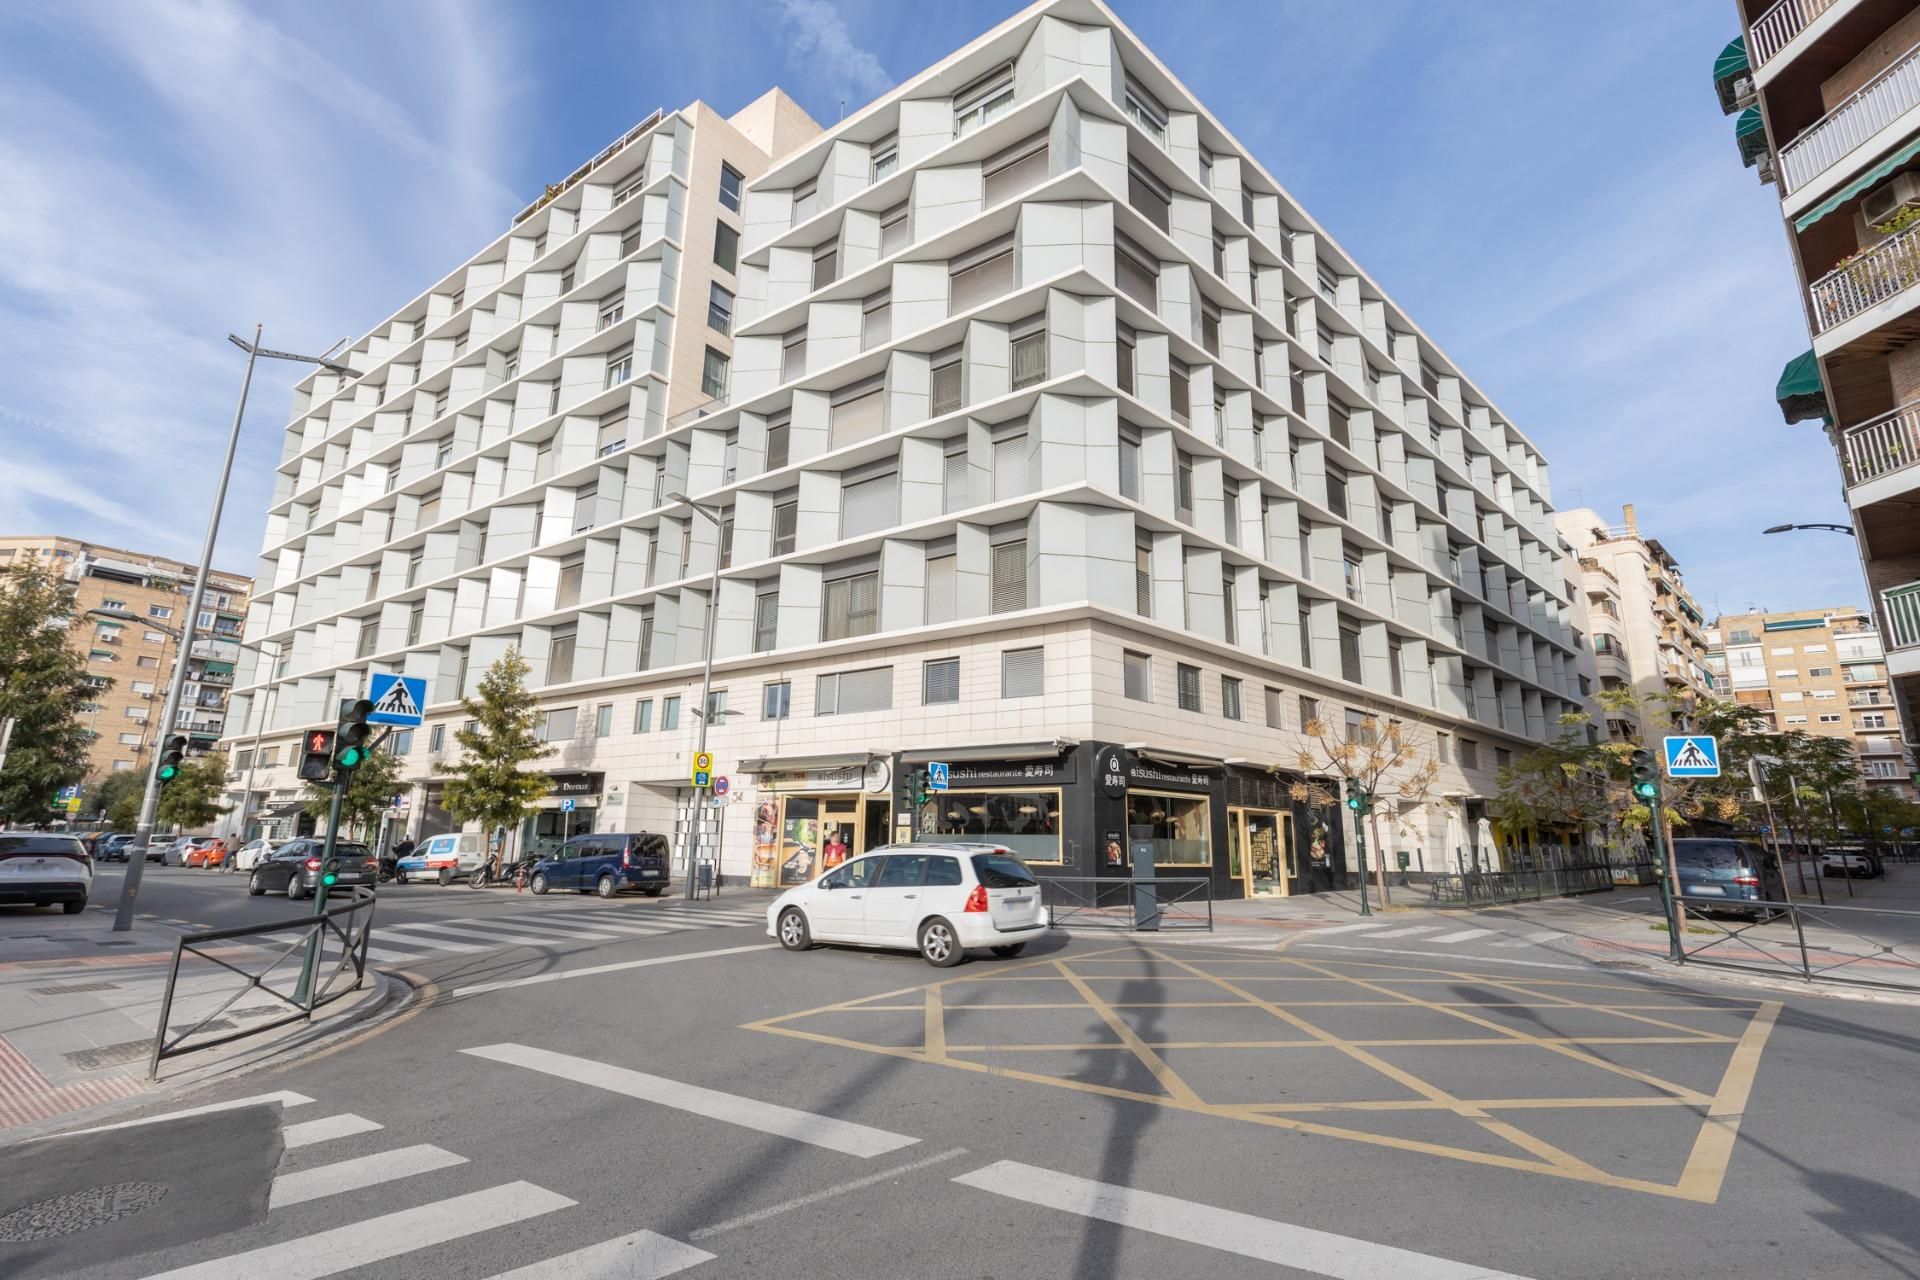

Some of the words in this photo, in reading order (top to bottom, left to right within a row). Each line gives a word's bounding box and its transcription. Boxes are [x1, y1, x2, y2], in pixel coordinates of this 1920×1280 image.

[948, 767, 977, 779] sushi
[978, 769, 1023, 778] restaurante
[1025, 764, 1054, 777] 愛寿司
[1130, 766, 1161, 780] aisushi
[1161, 774, 1190, 783] restaurante
[1105, 774, 1126, 787] 愛寿司
